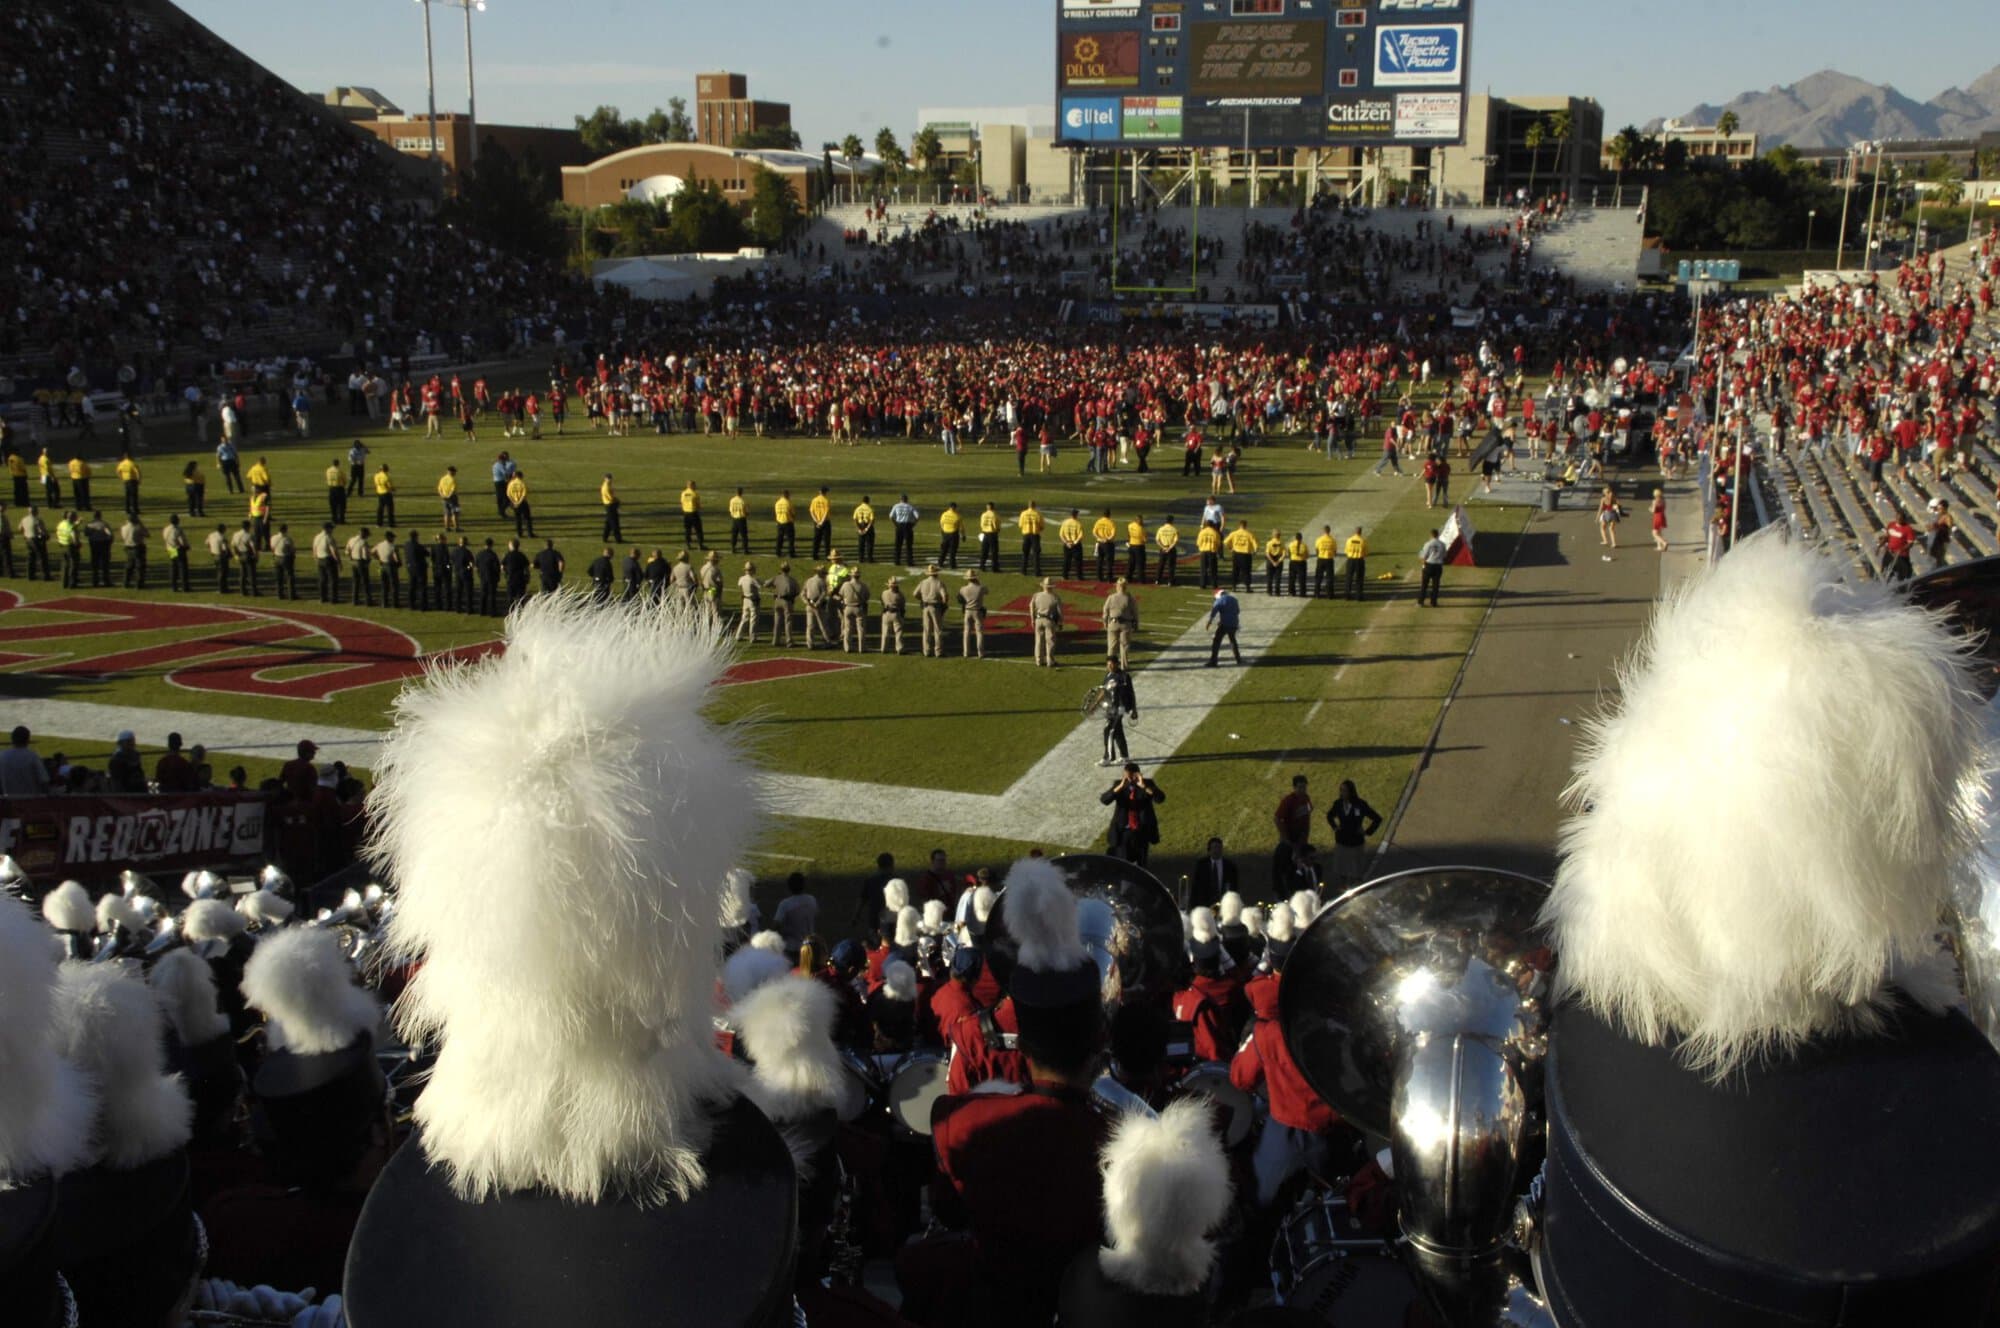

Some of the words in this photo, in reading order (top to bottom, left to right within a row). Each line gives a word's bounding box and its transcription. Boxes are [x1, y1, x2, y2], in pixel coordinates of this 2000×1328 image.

[1096, 8, 1138, 17] CHEVROLET
[1217, 24, 1297, 41] PLEASE
[1399, 33, 1440, 46] Tucson
[1203, 44, 1256, 60] STAY
[1260, 43, 1310, 59] OFF
[1402, 44, 1450, 57] Electric
[1407, 56, 1449, 67] Power
[1066, 64, 1083, 77] DEL
[1088, 64, 1105, 77] SOL
[1199, 63, 1243, 78] THE
[1247, 62, 1311, 78] FIELD
[1359, 100, 1390, 109] Tucson
[1328, 104, 1391, 122] Citizen
[65, 815, 138, 863] RED
[165, 805, 234, 855] ZONE
